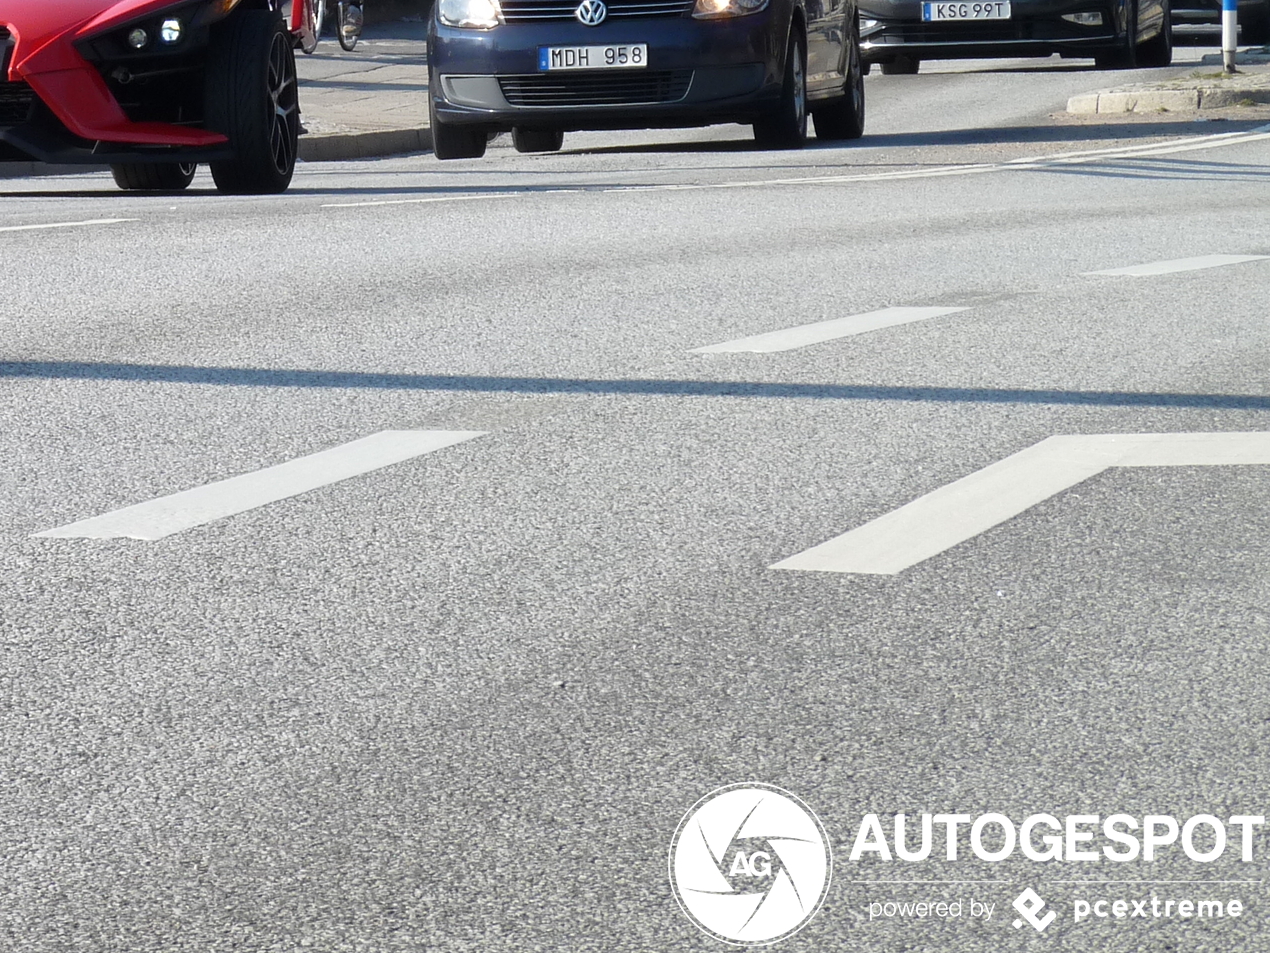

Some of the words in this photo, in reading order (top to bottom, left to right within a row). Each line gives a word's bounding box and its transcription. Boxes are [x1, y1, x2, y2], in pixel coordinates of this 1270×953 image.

[937, 3, 968, 19] KSG
[972, 2, 1004, 18] 99T
[551, 49, 589, 67] MDH
[604, 46, 642, 65] 958
